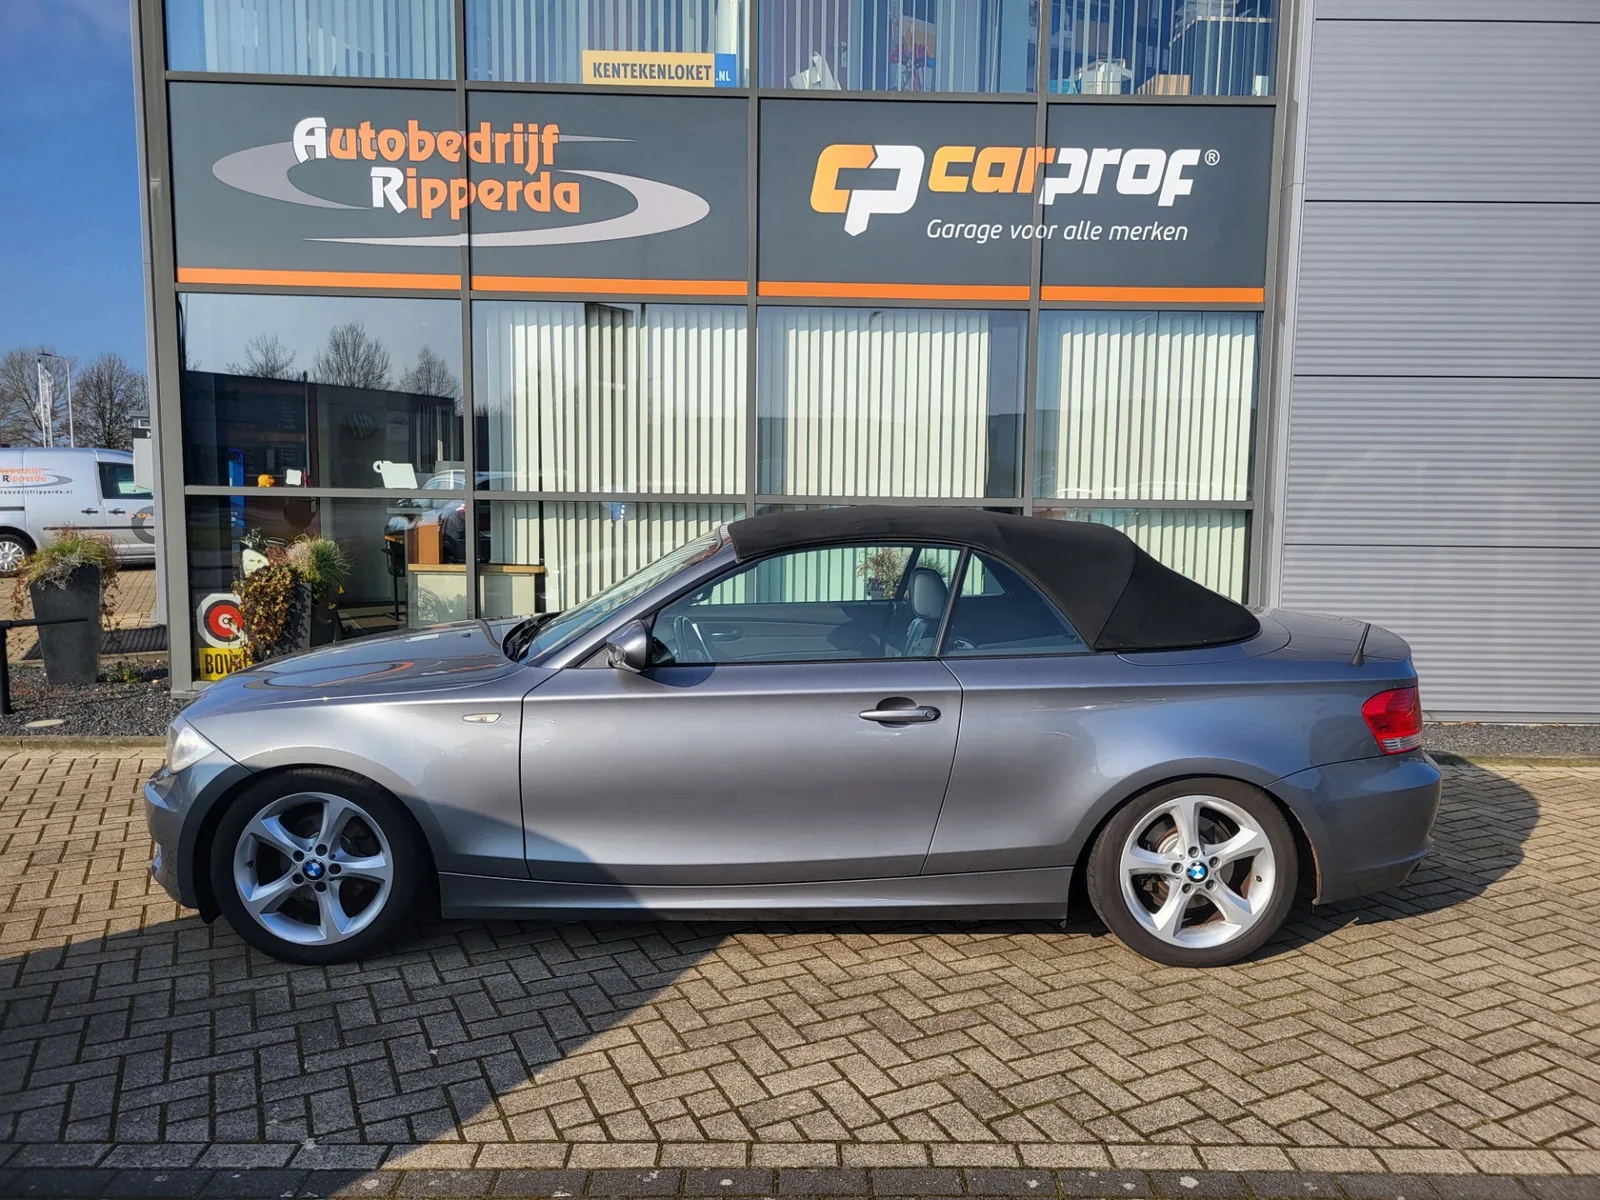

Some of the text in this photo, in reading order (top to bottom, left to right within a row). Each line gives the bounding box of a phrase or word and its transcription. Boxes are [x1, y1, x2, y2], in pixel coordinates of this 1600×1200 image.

[293, 117, 560, 174] Autobedrijf
[371, 166, 581, 220] Ripperda
[926, 219, 1189, 245] Garage voor alle merken
[2, 474, 47, 483] Ripperda
